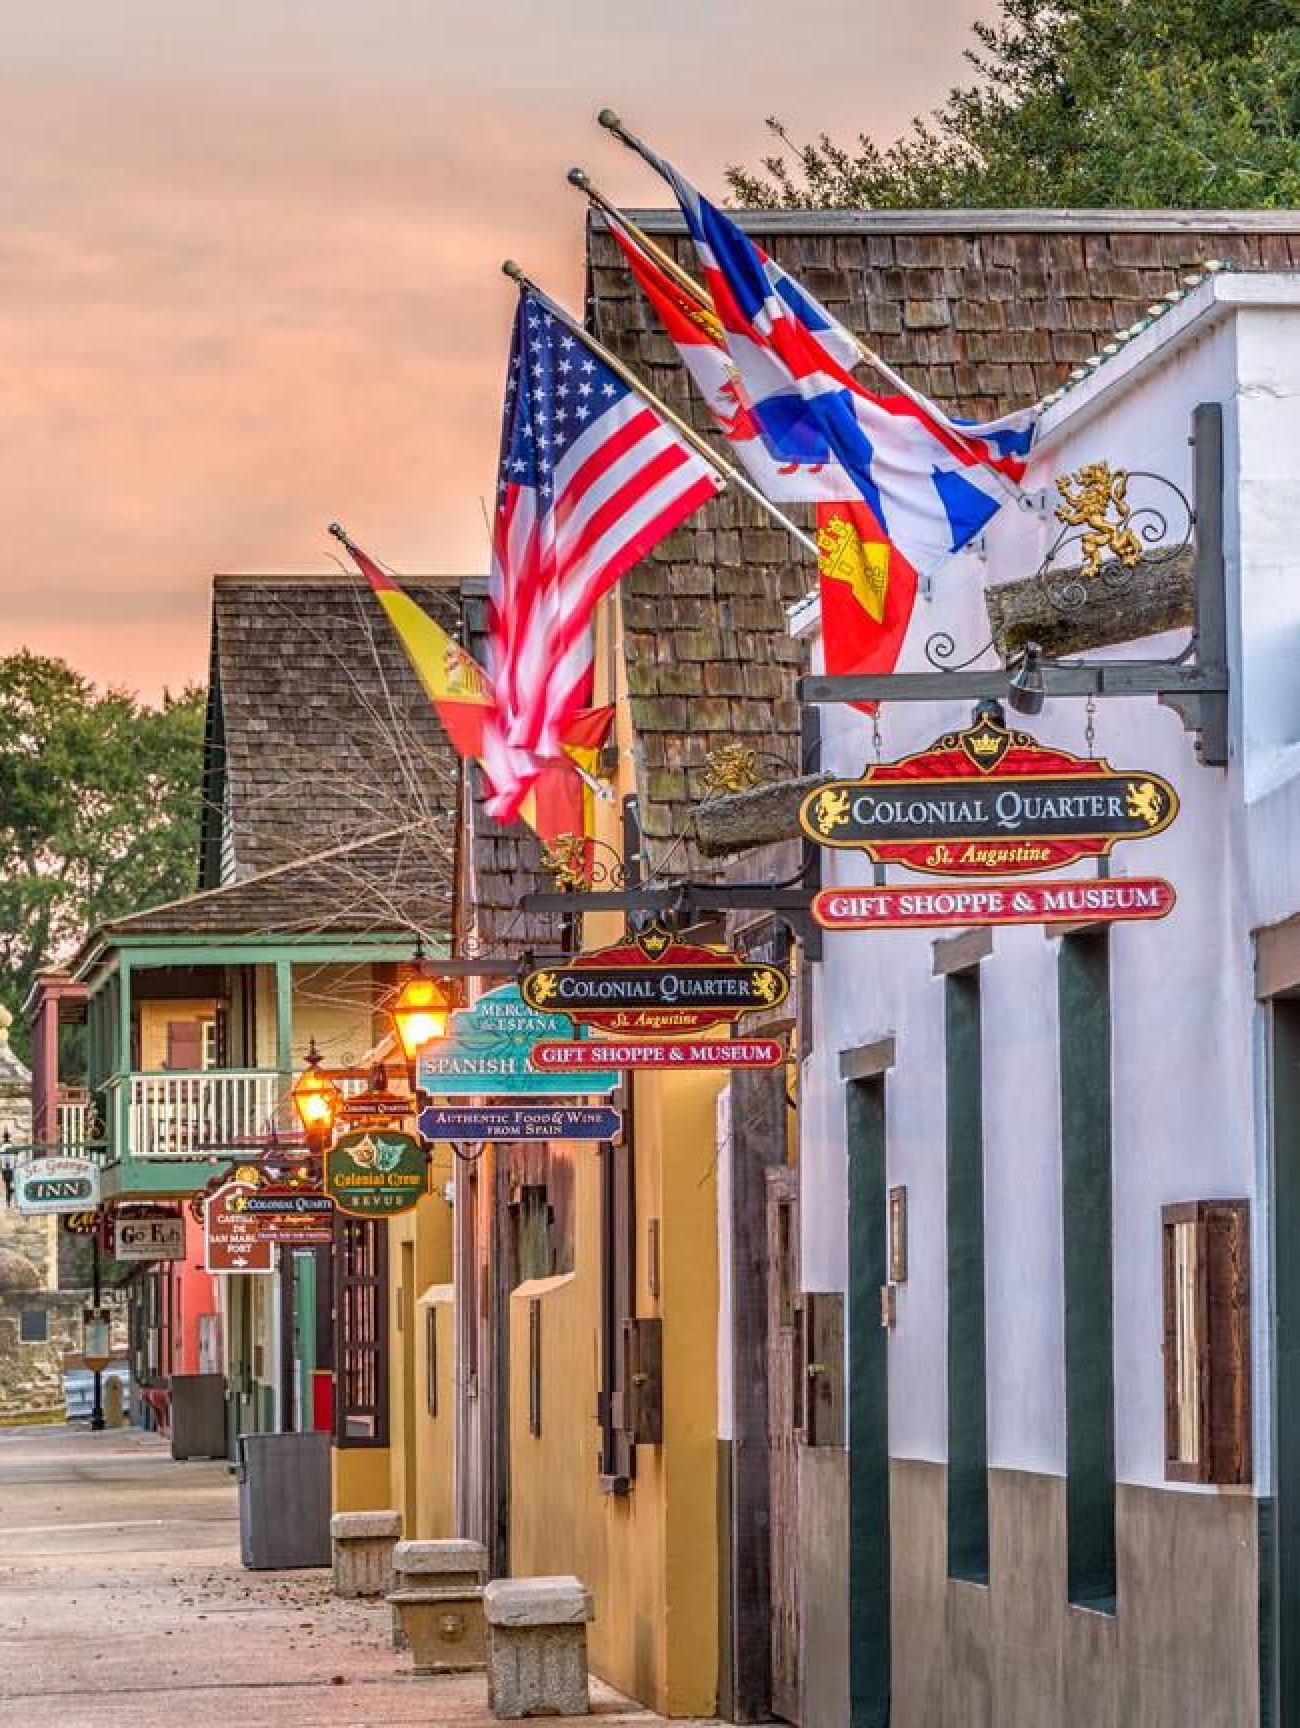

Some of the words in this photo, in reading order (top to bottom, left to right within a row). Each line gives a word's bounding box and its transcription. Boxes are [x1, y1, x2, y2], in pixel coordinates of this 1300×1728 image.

[852, 797, 988, 825] COLONIAL
[996, 791, 1124, 828] QUARTER
[926, 845, 953, 865] St.
[960, 842, 1051, 867] Augustine
[829, 896, 890, 917] GIFT
[899, 892, 1000, 915] SHOPPE
[1011, 891, 1035, 911] &
[1043, 888, 1160, 911] MUSEUM
[559, 977, 654, 997] COLONIAL
[660, 975, 750, 1002] QUARTER
[635, 1011, 698, 1028] Augustine
[541, 1048, 585, 1063] GIFT
[591, 1047, 665, 1062] SHOPPE
[669, 1047, 685, 1061] &
[689, 1046, 772, 1061] MUSEUM
[426, 1057, 515, 1075] SPANISH
[436, 1112, 509, 1123] AUTHENTIC
[515, 1111, 551, 1123] FOOD
[566, 1111, 602, 1123] WINE
[487, 1125, 521, 1135] FROM
[525, 1123, 563, 1135] SPAIN
[333, 1172, 385, 1187] Colonial
[37, 1181, 79, 1197] INN
[247, 1199, 295, 1210] COLONIAL
[351, 1195, 403, 1206] REVUE
[121, 1225, 146, 1244] Go
[227, 1243, 253, 1253] FORT
